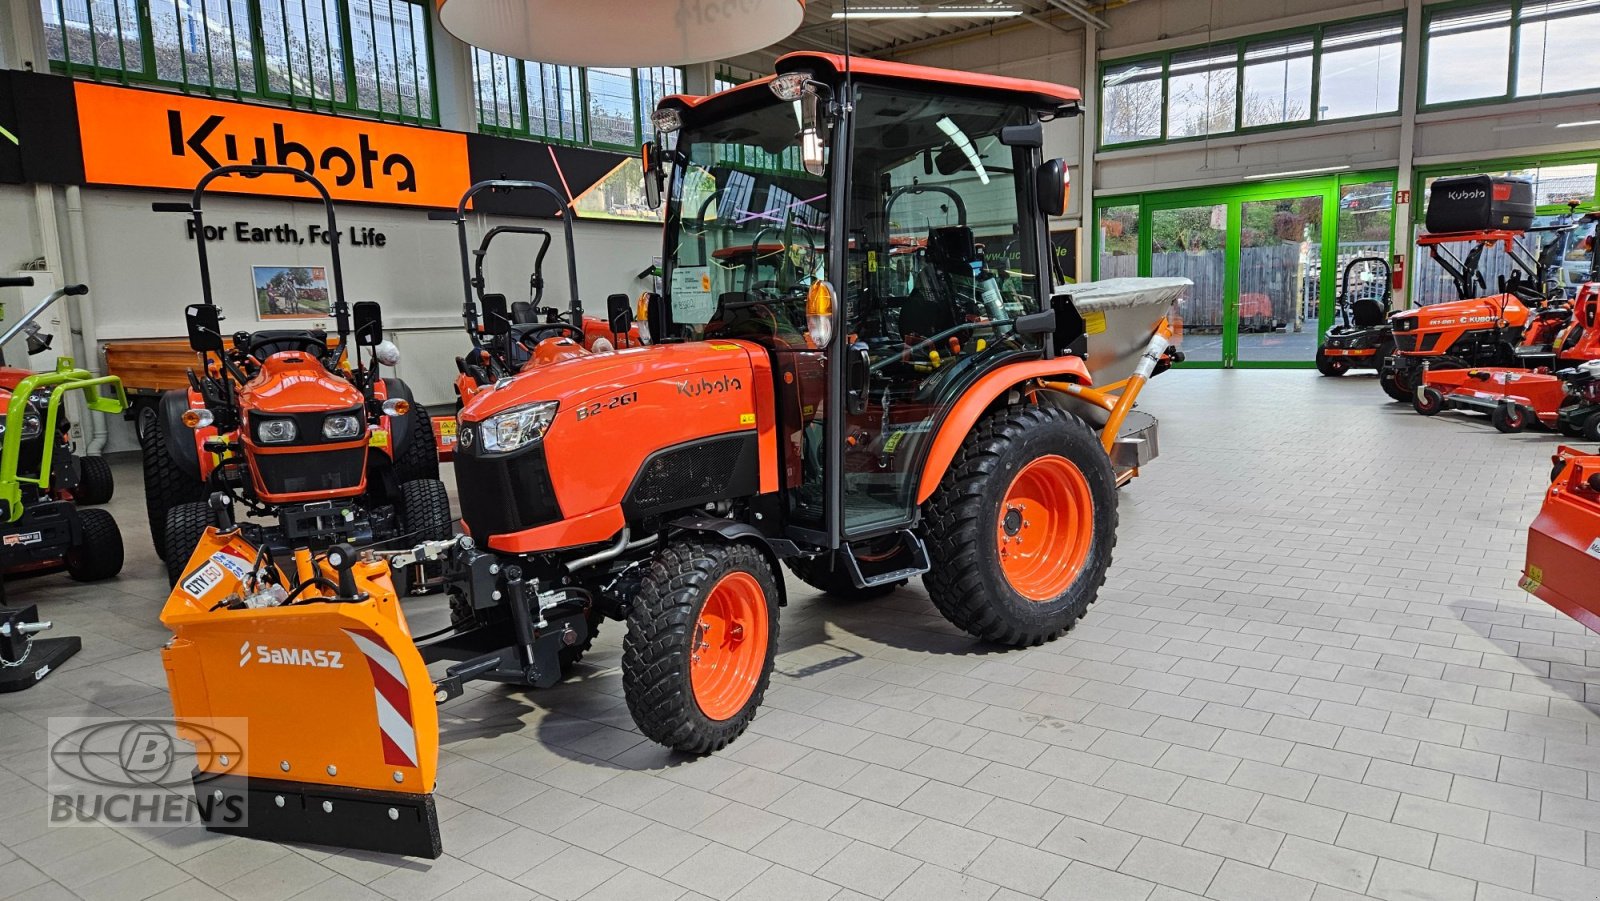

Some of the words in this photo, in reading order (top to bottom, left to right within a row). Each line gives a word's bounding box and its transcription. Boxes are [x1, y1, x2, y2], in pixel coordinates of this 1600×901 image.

[167, 109, 416, 193] Kubota
[1448, 189, 1486, 200] Kubota
[187, 219, 227, 240] For
[235, 222, 304, 245] Earth,
[350, 226, 387, 247] Life
[676, 375, 742, 398] Kubota
[576, 391, 638, 421] B2-261
[185, 575, 209, 595] CITY
[202, 566, 222, 582] 150
[256, 645, 344, 669] SaMASZ
